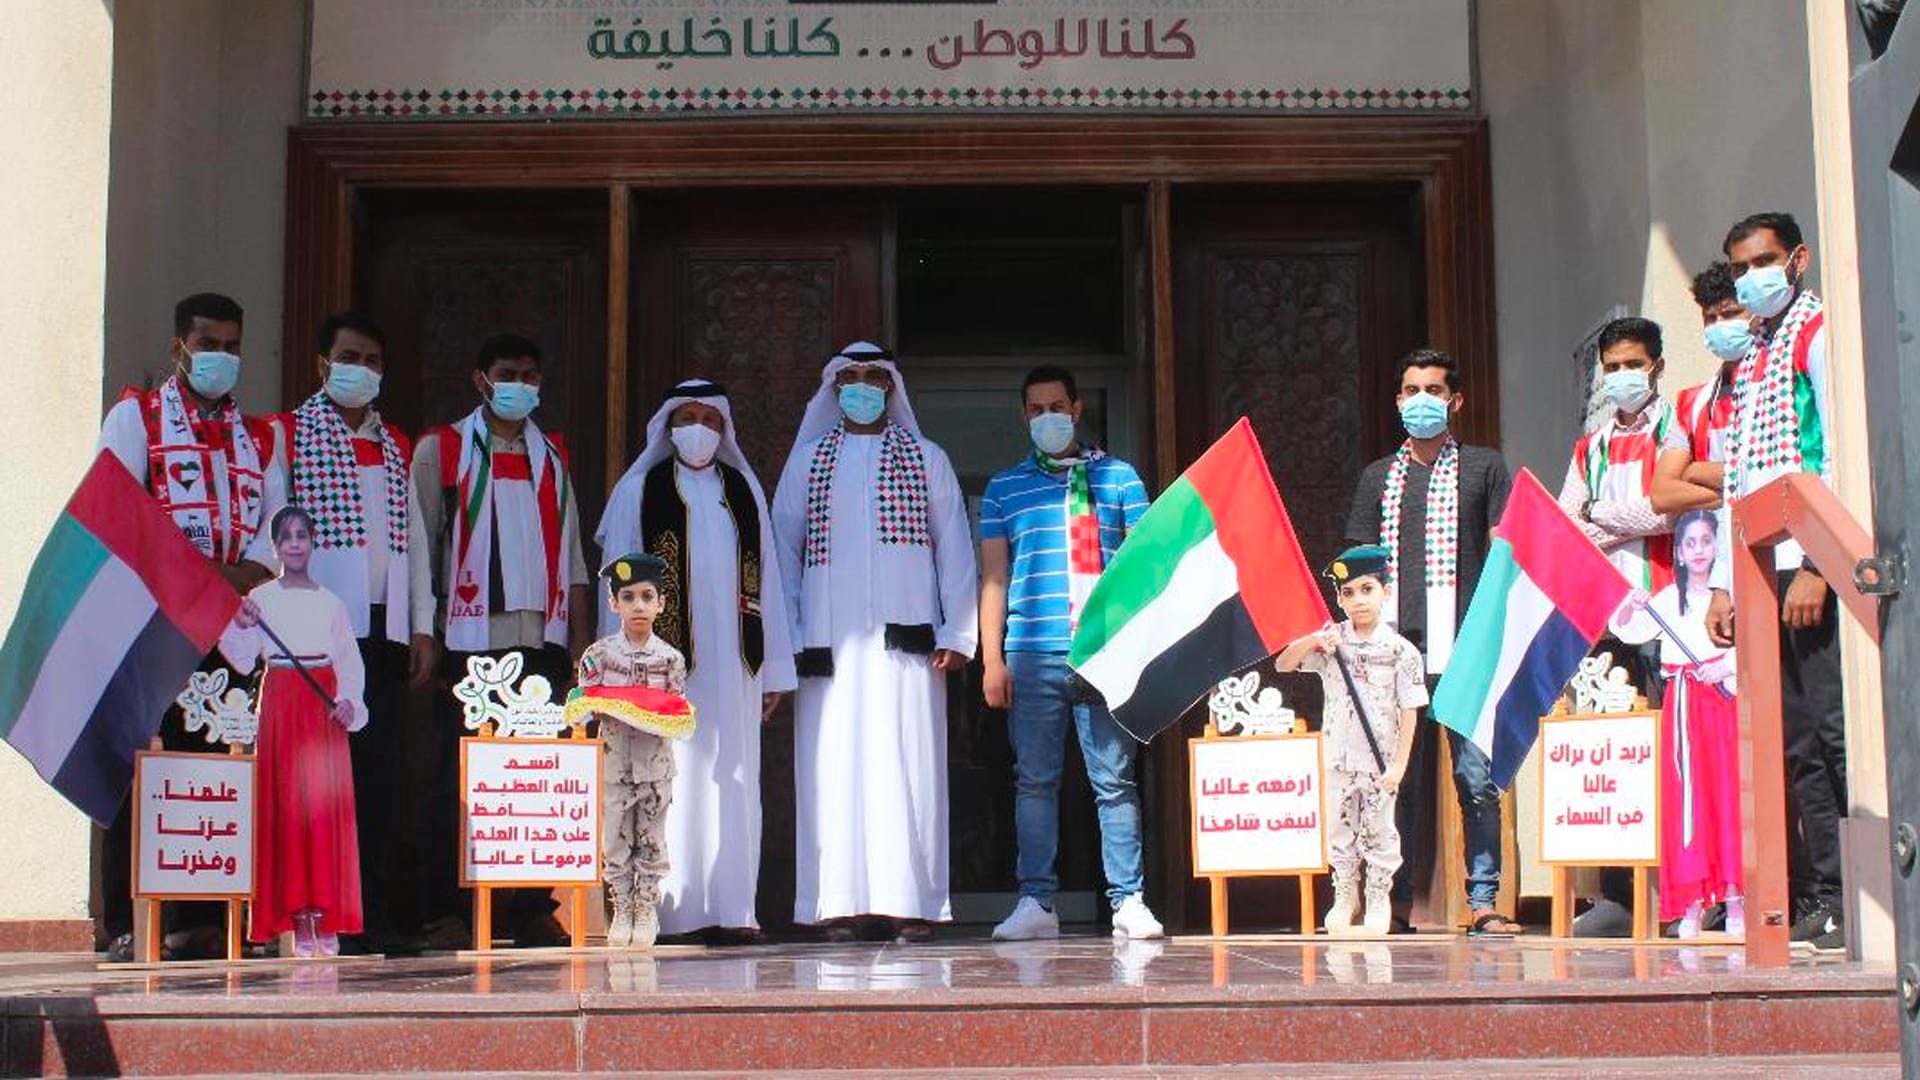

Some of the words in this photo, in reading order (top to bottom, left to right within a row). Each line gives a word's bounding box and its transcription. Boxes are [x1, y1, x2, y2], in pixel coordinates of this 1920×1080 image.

[587, 17, 732, 70] خليفة
[743, 17, 840, 57] كلنا
[926, 17, 1088, 70] للوطن
[1098, 17, 1196, 59] كلنا
[503, 752, 559, 770] أقسم
[472, 779, 548, 797] العظيم
[554, 779, 589, 797] بالله
[569, 801, 589, 821] أن
[1554, 805, 1611, 826] السماء
[1617, 806, 1644, 831] في
[157, 813, 238, 841] عزنا
[471, 826, 519, 841] العلم
[524, 826, 558, 841] هذا
[562, 826, 590, 842] على
[158, 848, 238, 876] وفخرنا
